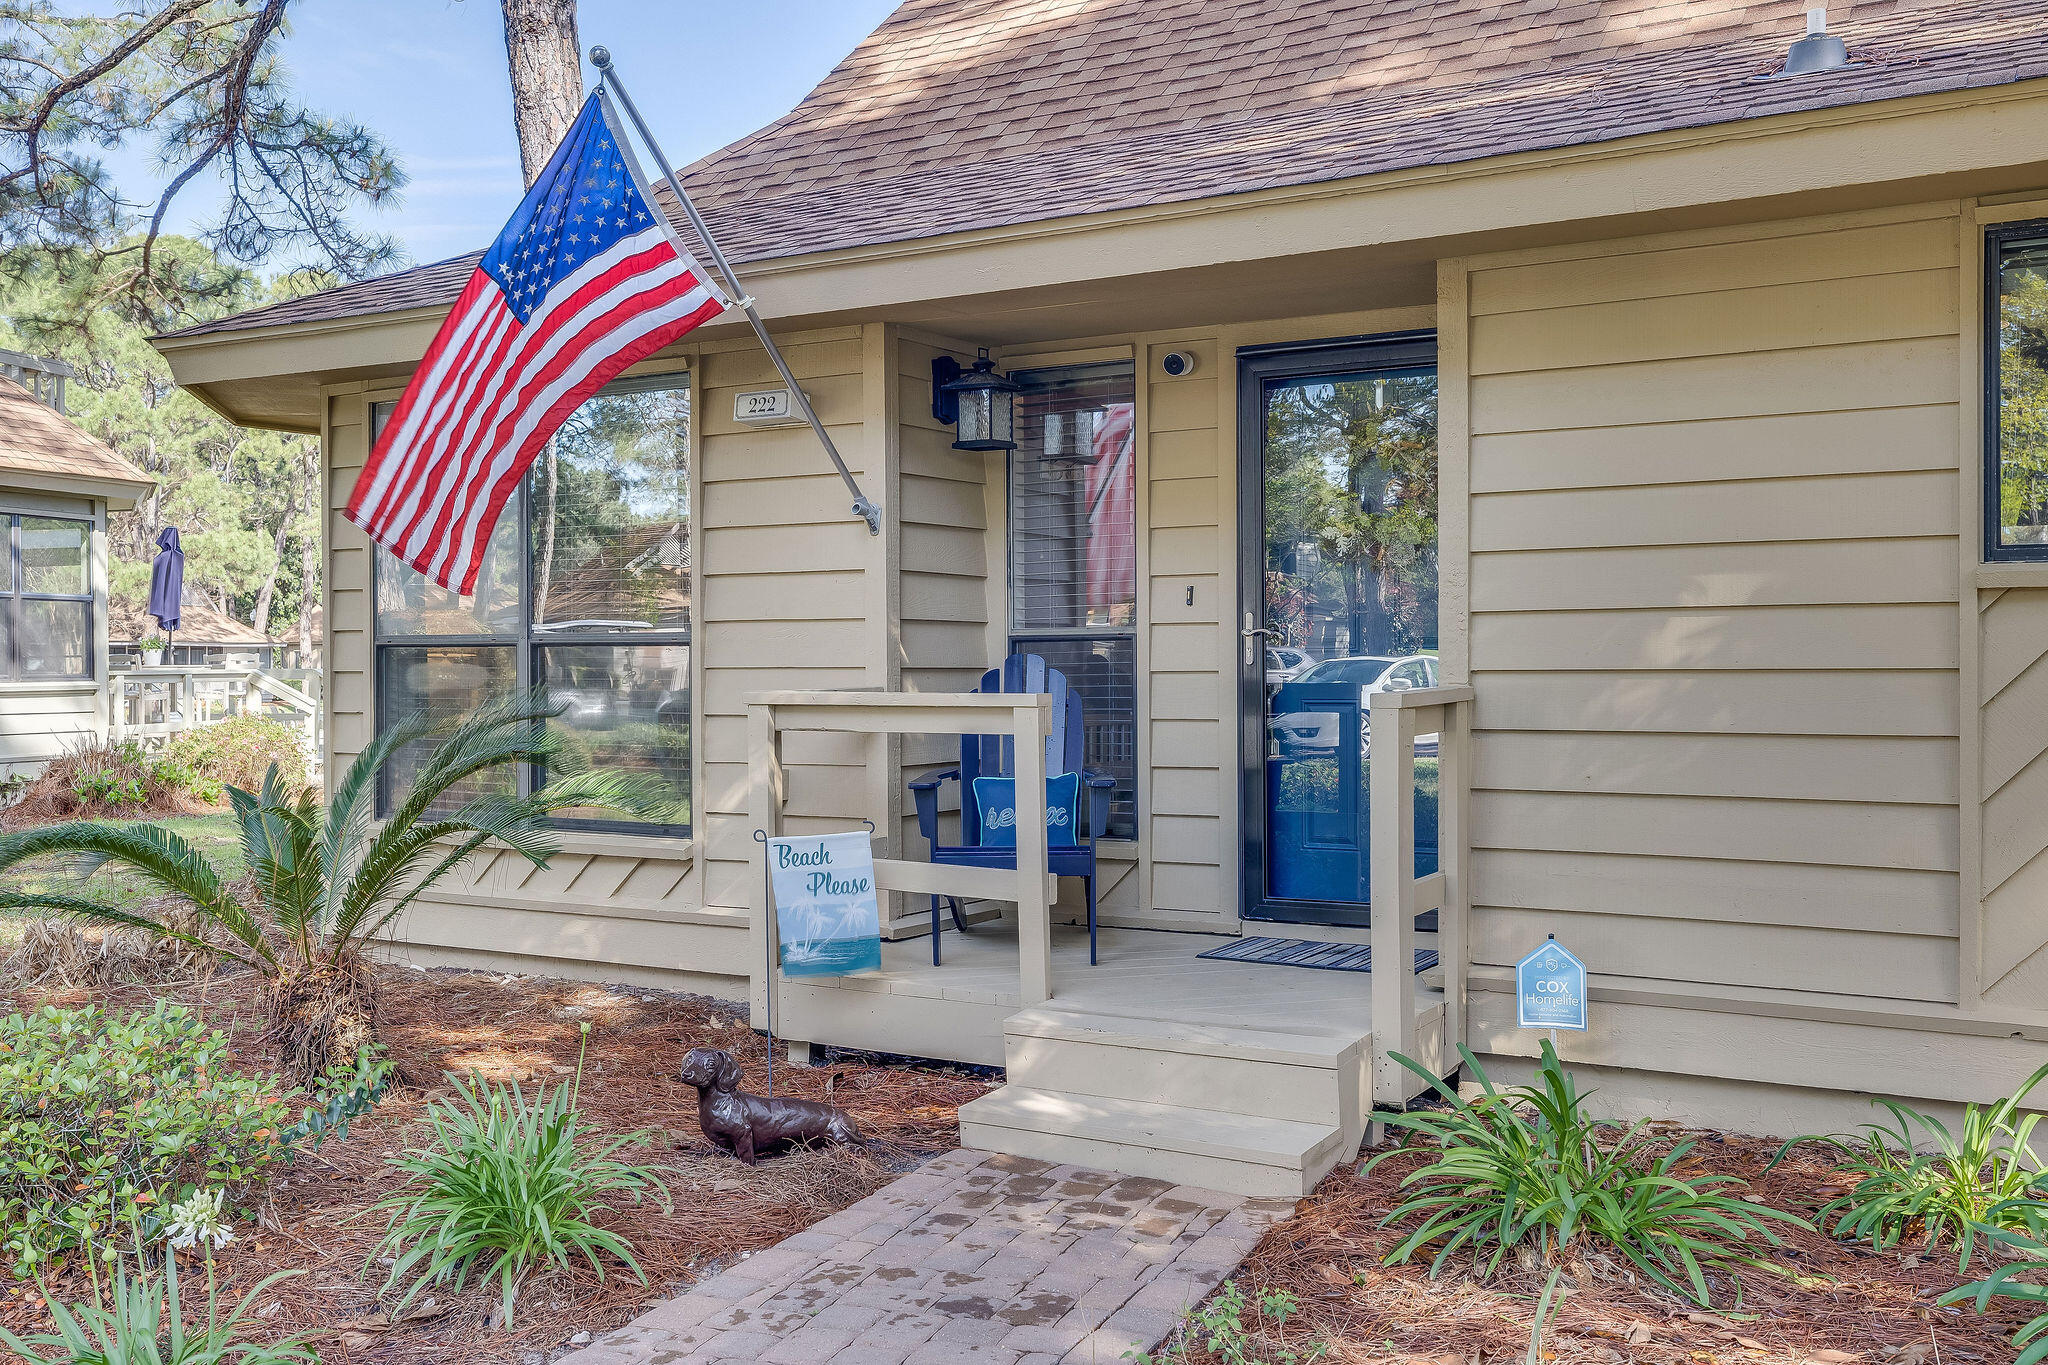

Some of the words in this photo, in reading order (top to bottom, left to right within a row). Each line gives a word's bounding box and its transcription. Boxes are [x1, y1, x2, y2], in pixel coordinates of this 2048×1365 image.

[748, 396, 776, 413] 222
[985, 806, 1069, 830] rex
[773, 842, 833, 869] Beach
[806, 871, 871, 897] Please
[1535, 980, 1569, 993] COX
[1525, 993, 1580, 1007] Homelife
